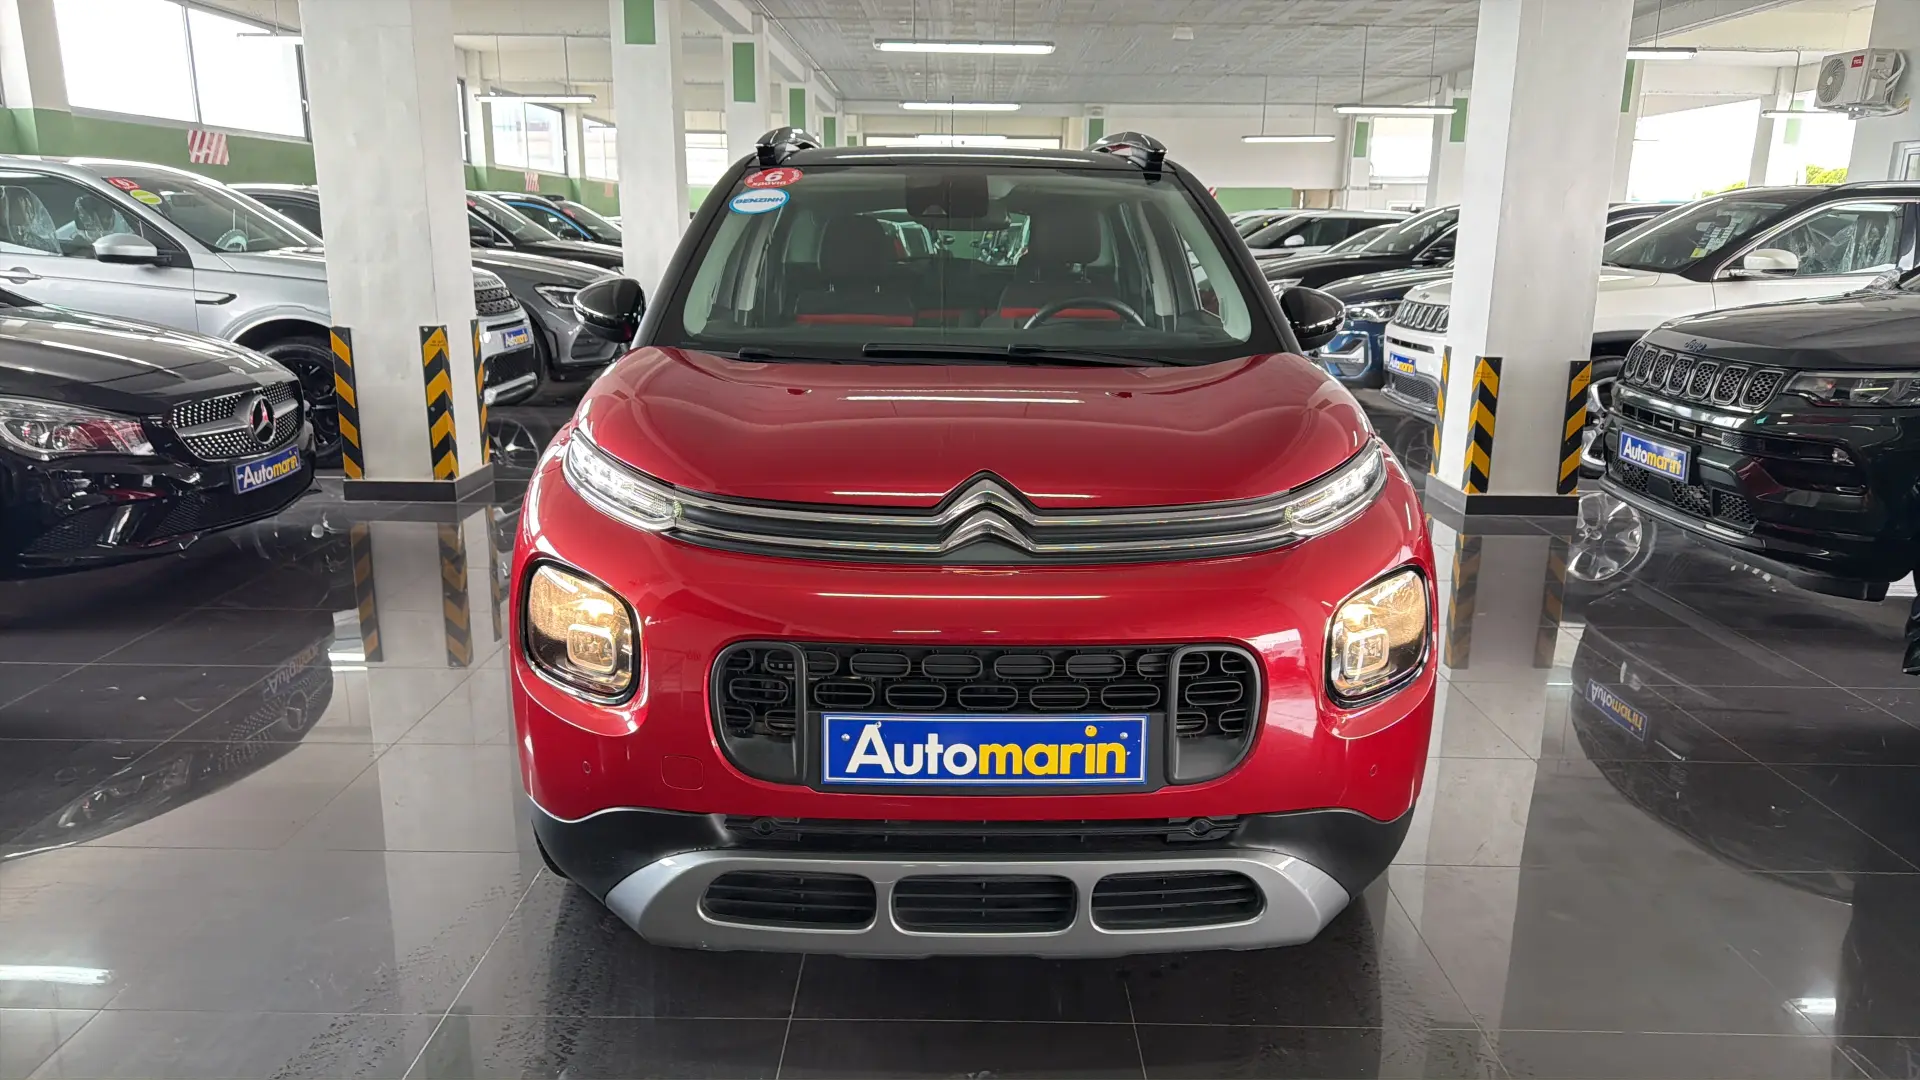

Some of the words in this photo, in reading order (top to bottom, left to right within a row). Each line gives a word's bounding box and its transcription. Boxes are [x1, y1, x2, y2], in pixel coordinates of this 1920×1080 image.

[765, 171, 784, 182] 6
[243, 450, 298, 488] Automarin
[1623, 437, 1682, 475] Automarin
[845, 723, 1127, 776] Automarin
